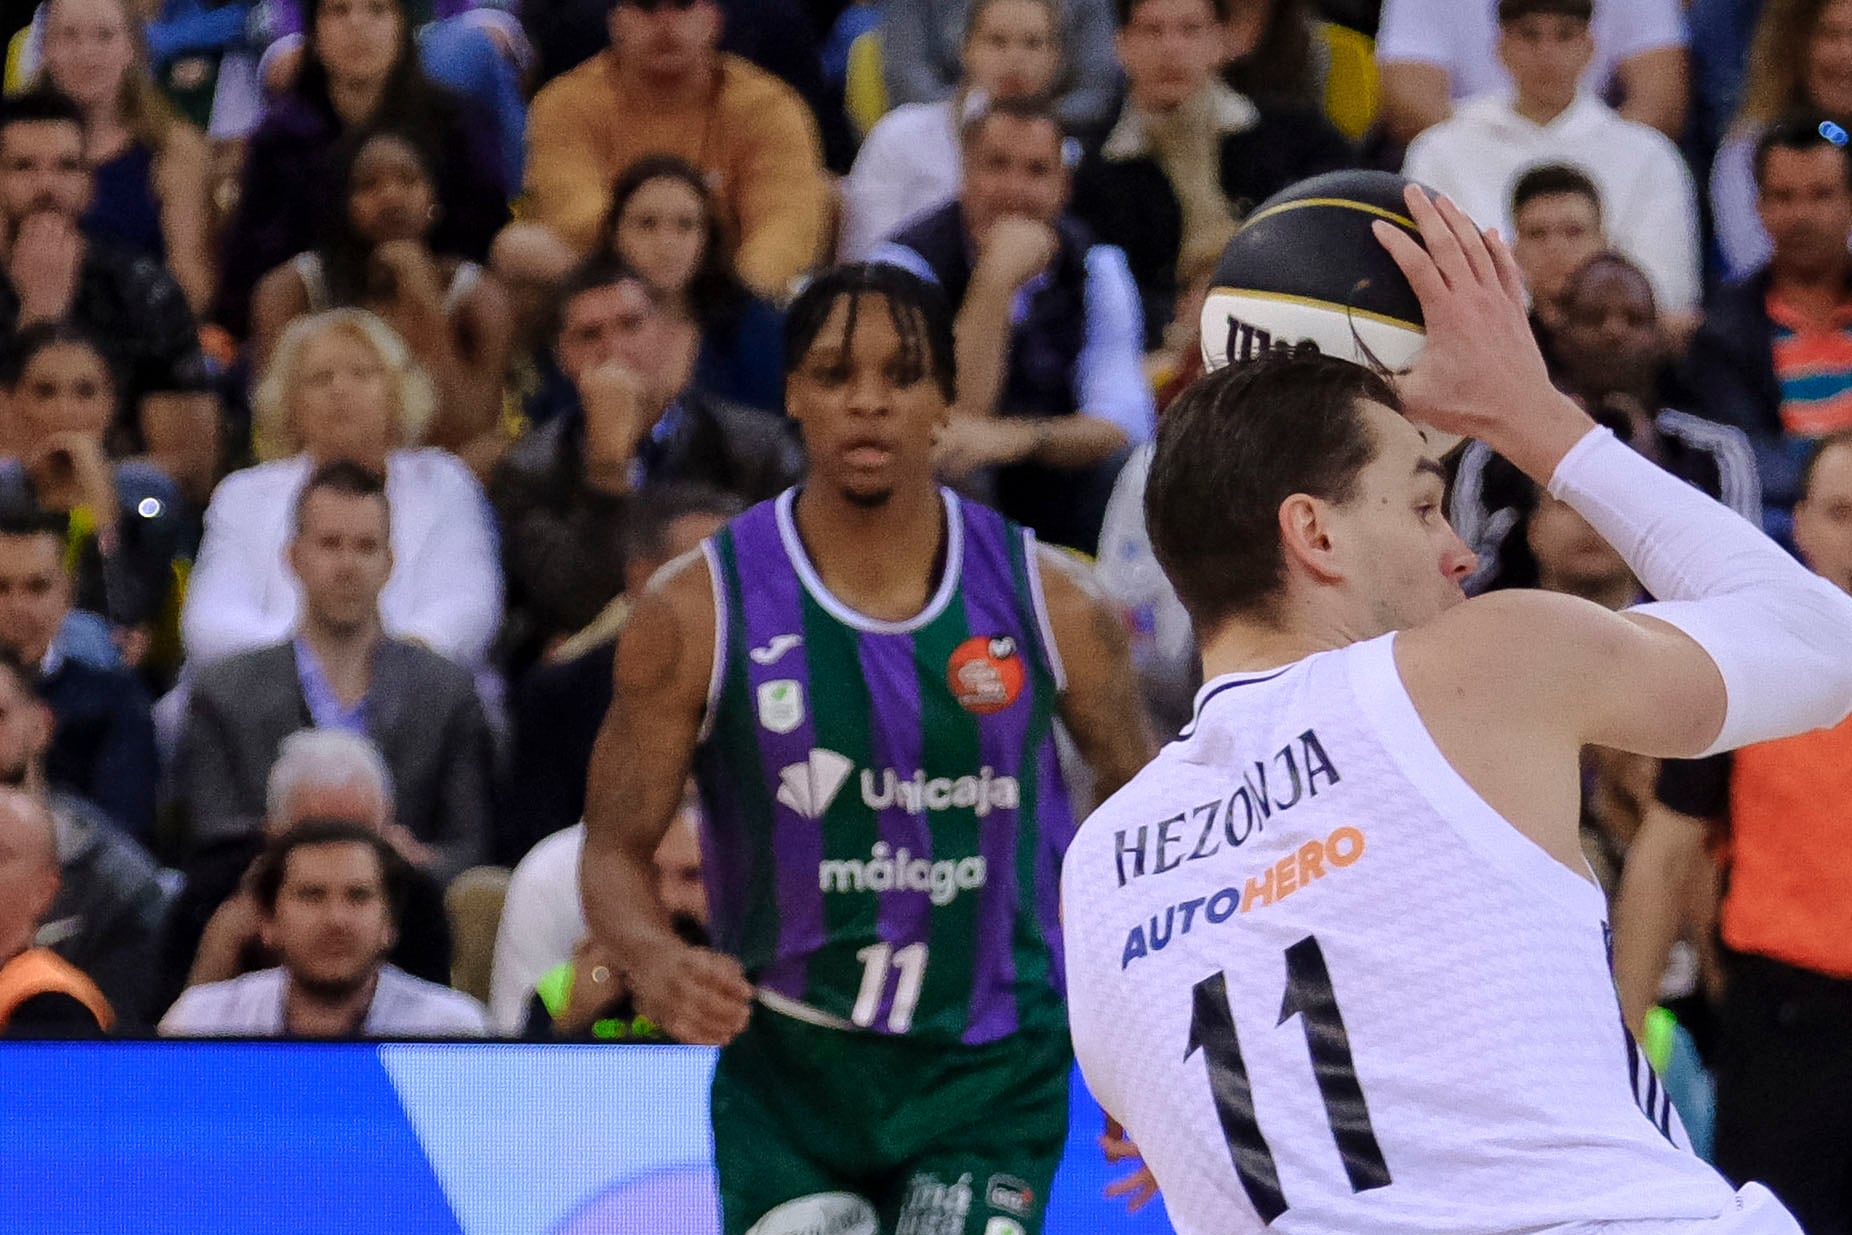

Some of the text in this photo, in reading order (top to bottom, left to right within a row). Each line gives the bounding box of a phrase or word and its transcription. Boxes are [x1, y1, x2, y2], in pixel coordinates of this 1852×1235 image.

[860, 765, 1020, 817] Unicaja
[1114, 729, 1341, 888] HEZONJA
[1121, 826, 1366, 971] AUTOHERO
[851, 941, 929, 1034] 11
[1182, 934, 1392, 1226] 11
